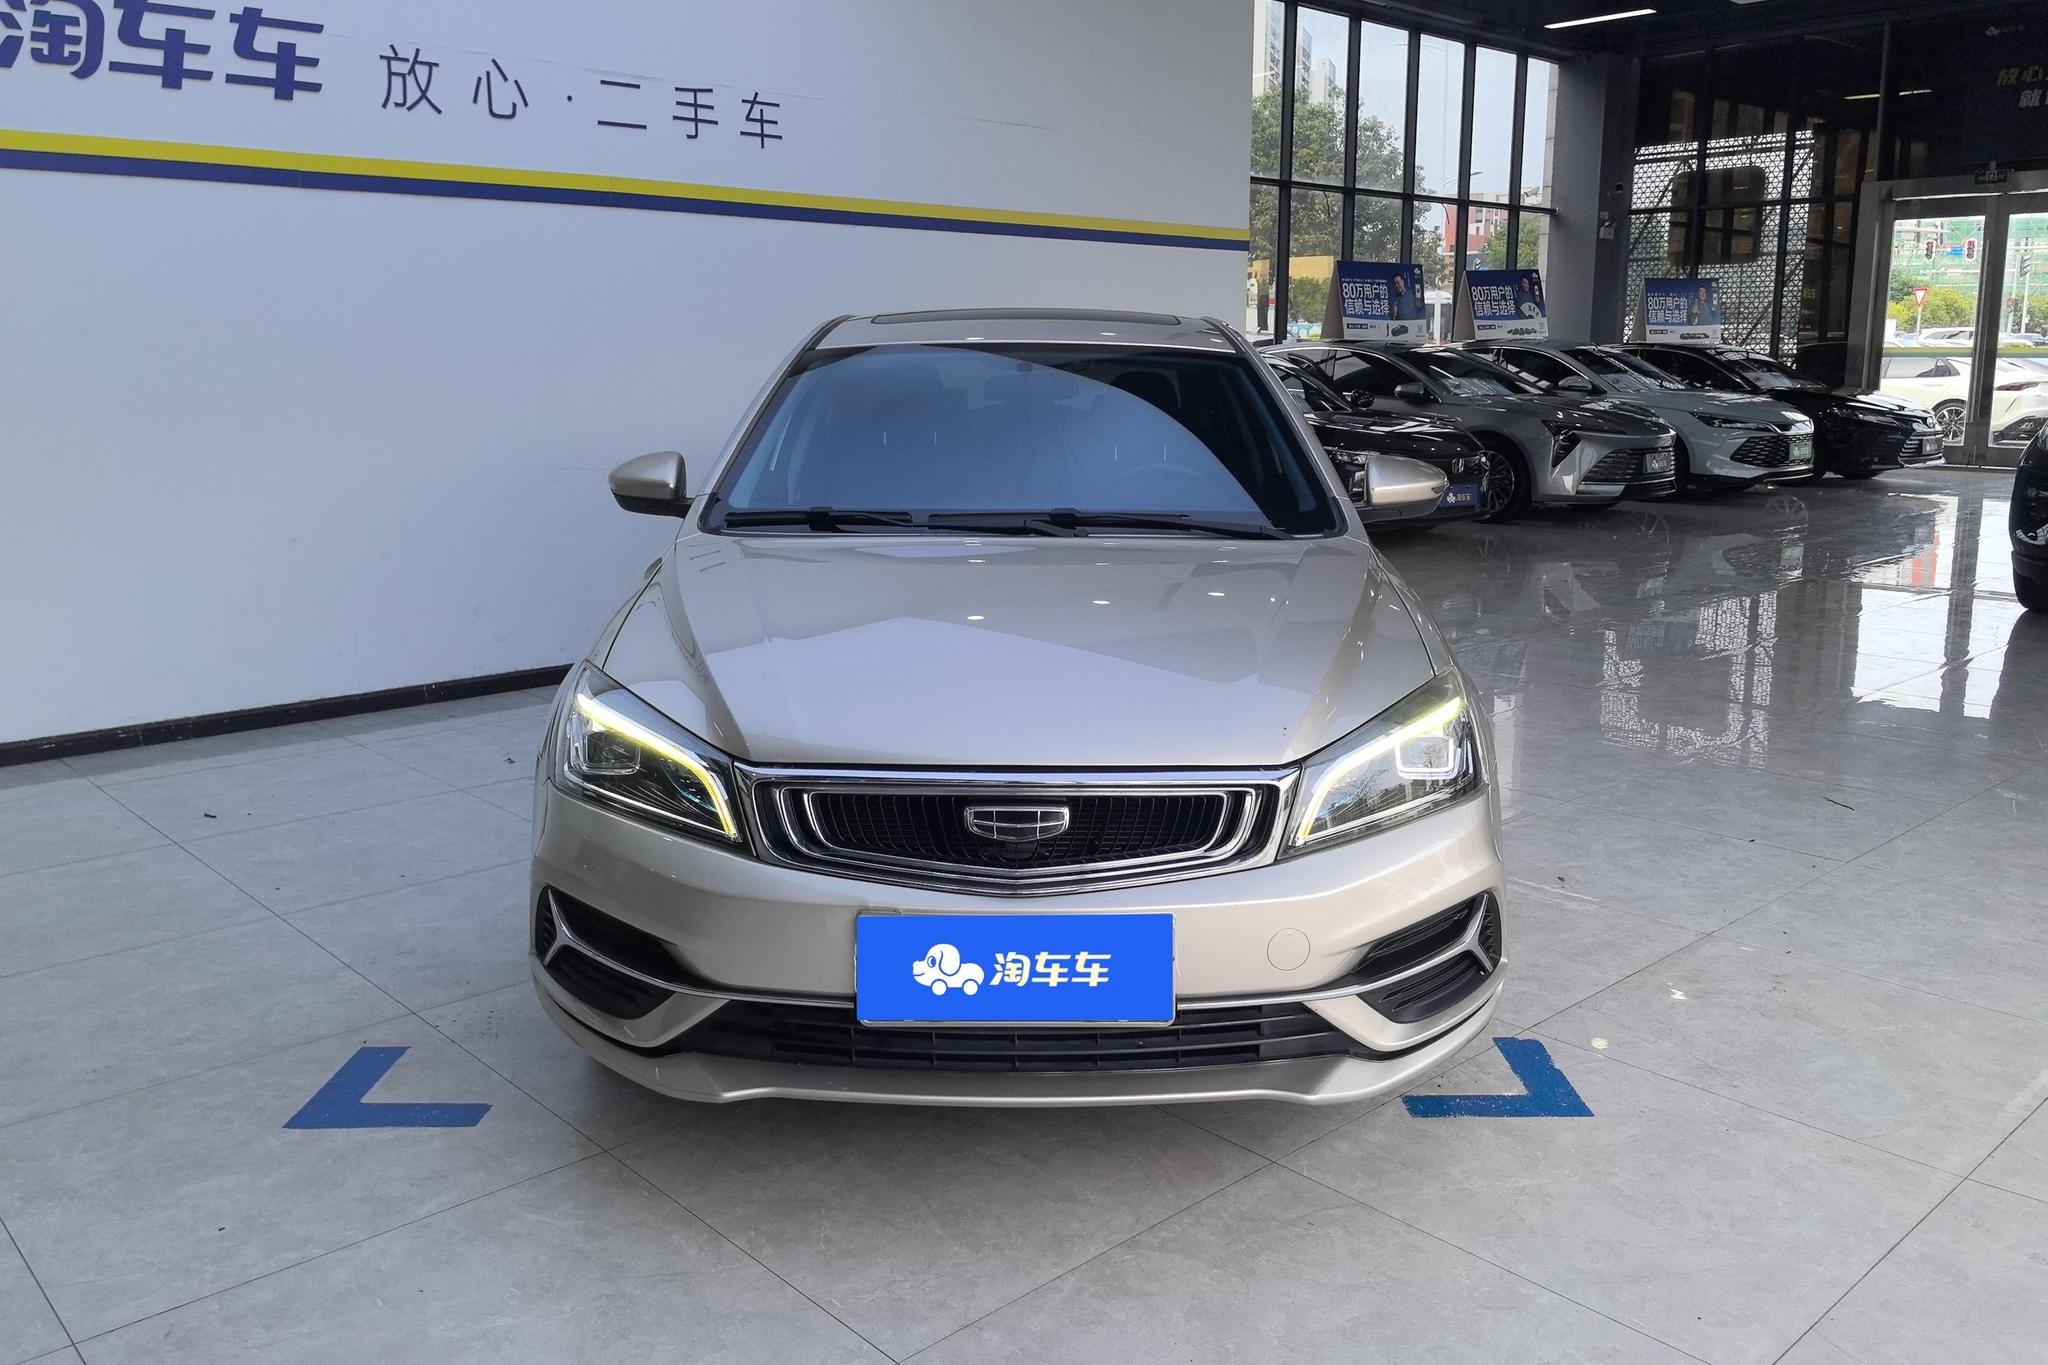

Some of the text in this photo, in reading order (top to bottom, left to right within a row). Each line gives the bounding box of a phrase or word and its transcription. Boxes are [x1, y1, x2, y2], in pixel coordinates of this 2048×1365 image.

[0, 0, 324, 100] 淘车车
[1995, 64, 2048, 87] 放心
[1342, 282, 1389, 299] 80万用户的
[1471, 285, 1514, 301] 80万用户的
[1344, 299, 1390, 316] 信赖与选择
[1474, 300, 1516, 316] 信赖与选择
[1647, 296, 1688, 310] 80万用户的
[1648, 309, 1688, 323] 信赖与选择
